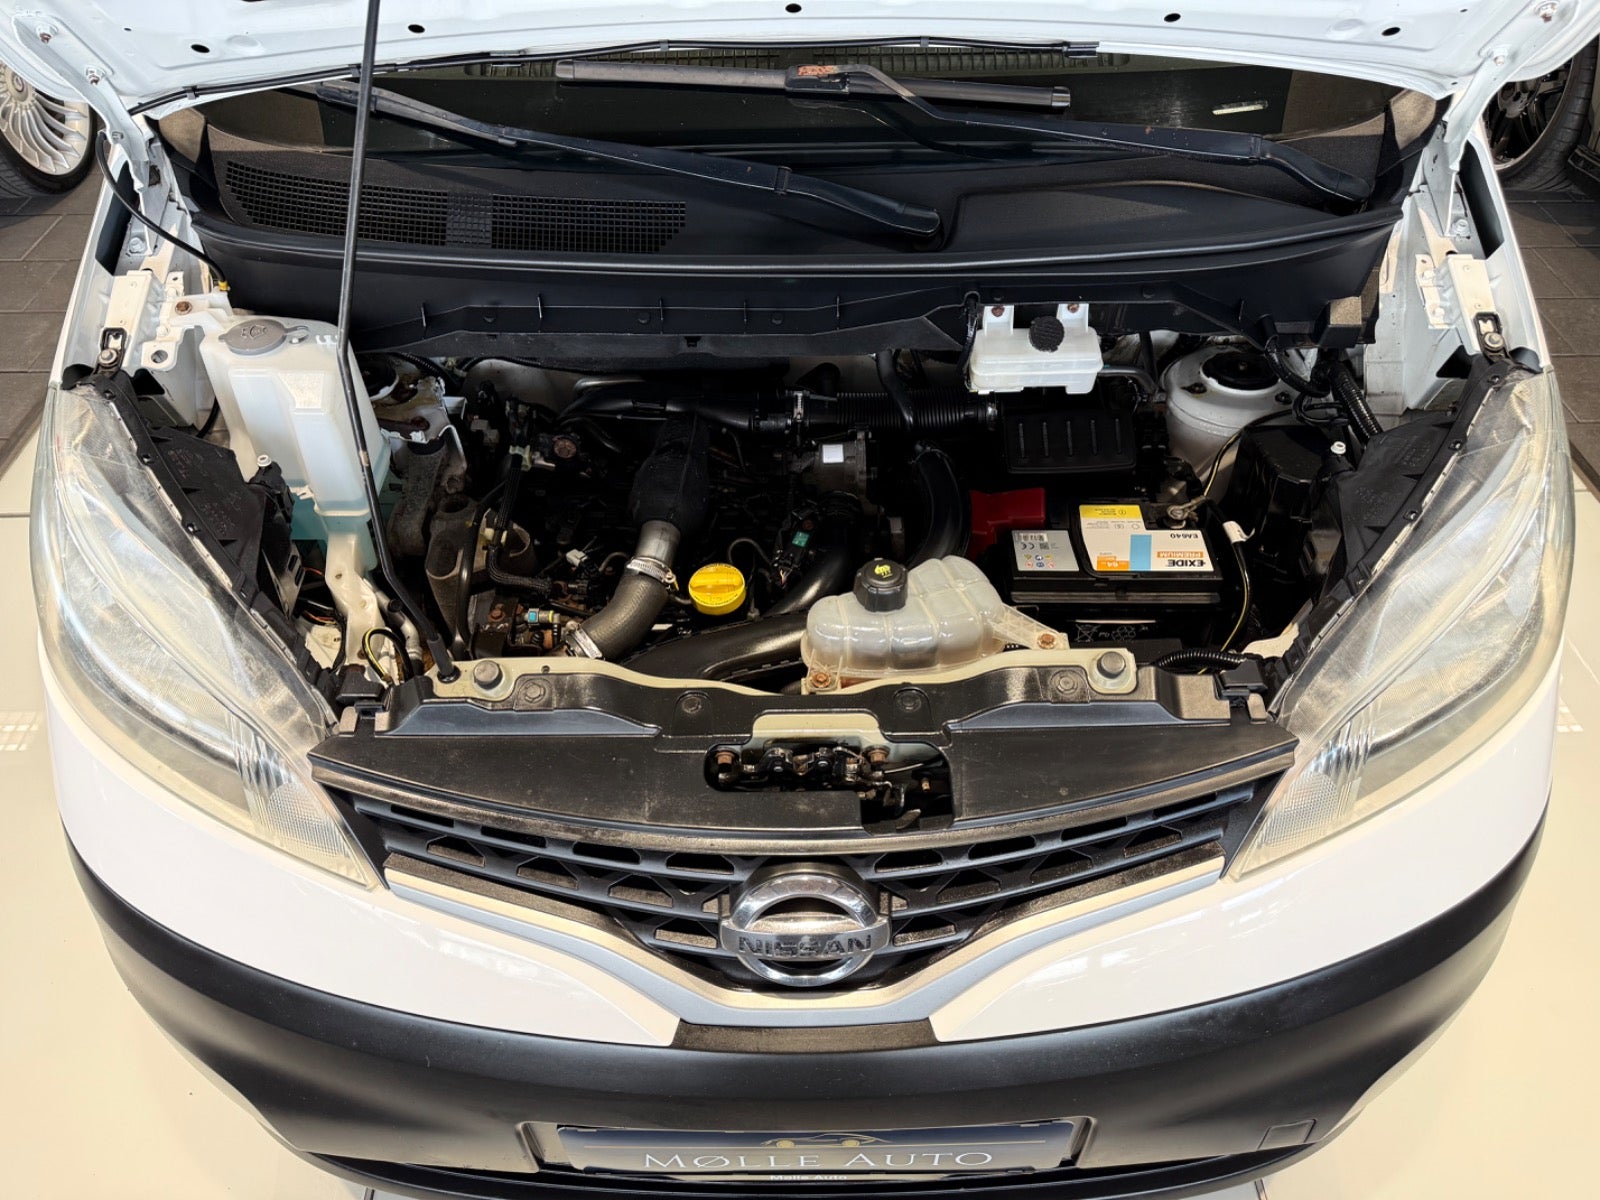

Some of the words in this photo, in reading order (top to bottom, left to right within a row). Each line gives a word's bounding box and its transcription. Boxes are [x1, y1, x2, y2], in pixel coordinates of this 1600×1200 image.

[1167, 559, 1206, 568] EXIDE
[738, 934, 873, 957] NISSAN
[644, 1153, 822, 1169] MØLLE
[845, 1152, 993, 1167] AUTO
